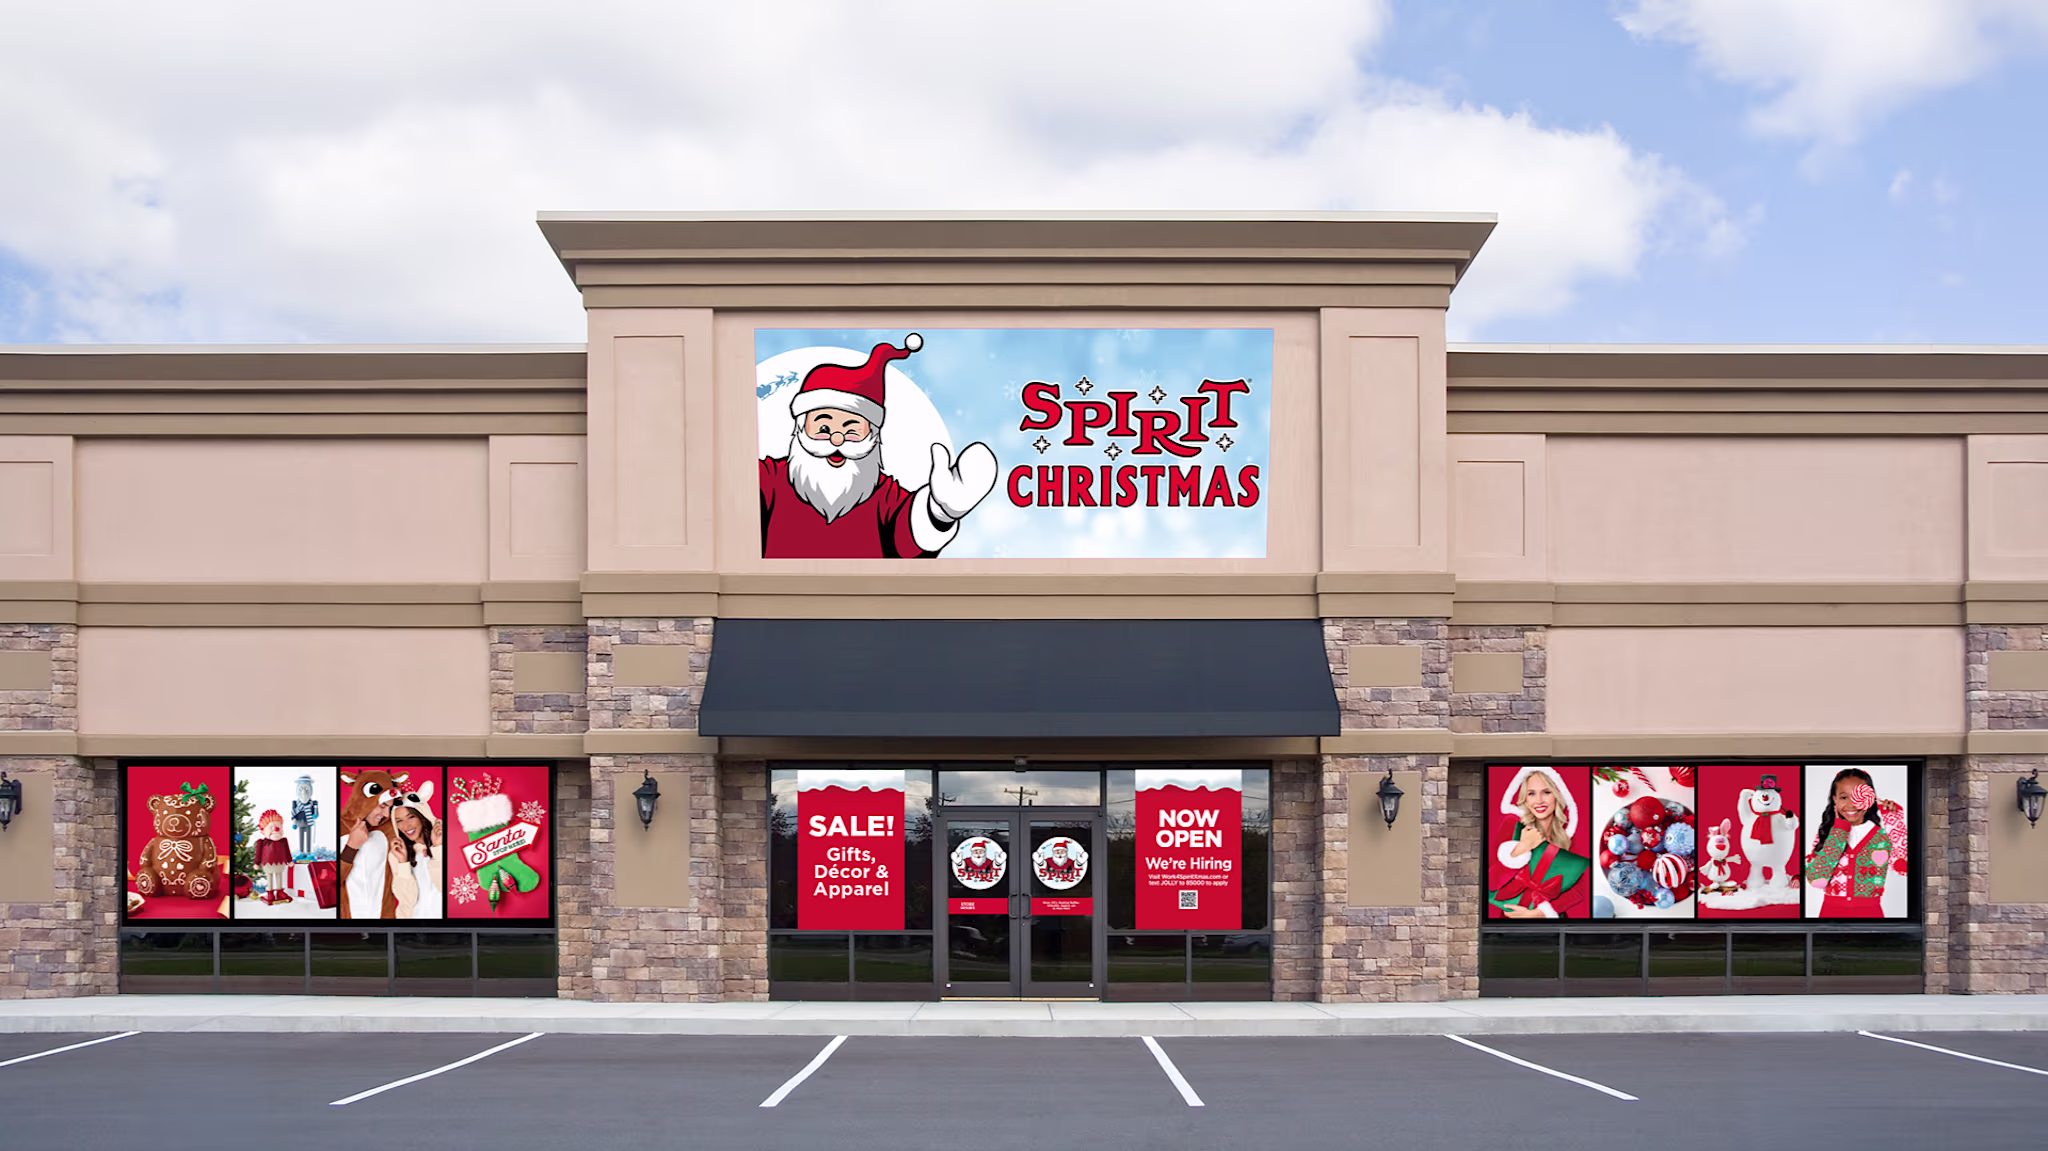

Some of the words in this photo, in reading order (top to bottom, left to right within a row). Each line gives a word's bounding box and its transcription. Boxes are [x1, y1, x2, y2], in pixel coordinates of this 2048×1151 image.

[1019, 379, 1251, 458] SPIRIT
[1007, 465, 1260, 507] CHRISTMAS
[808, 815, 894, 837] SALE!
[1159, 809, 1220, 828] NOW
[471, 829, 526, 865] Santa
[1155, 829, 1222, 848] OPEN
[826, 846, 876, 864] Gifts,
[1145, 857, 1187, 870] We’re
[1190, 856, 1232, 872] Hiring
[814, 863, 870, 879] Décor
[875, 864, 889, 879] &
[957, 867, 1002, 883] SPIRIT
[1039, 867, 1083, 883] SPIRIT
[813, 881, 889, 899] Apparel
[1213, 880, 1229, 888] apply
